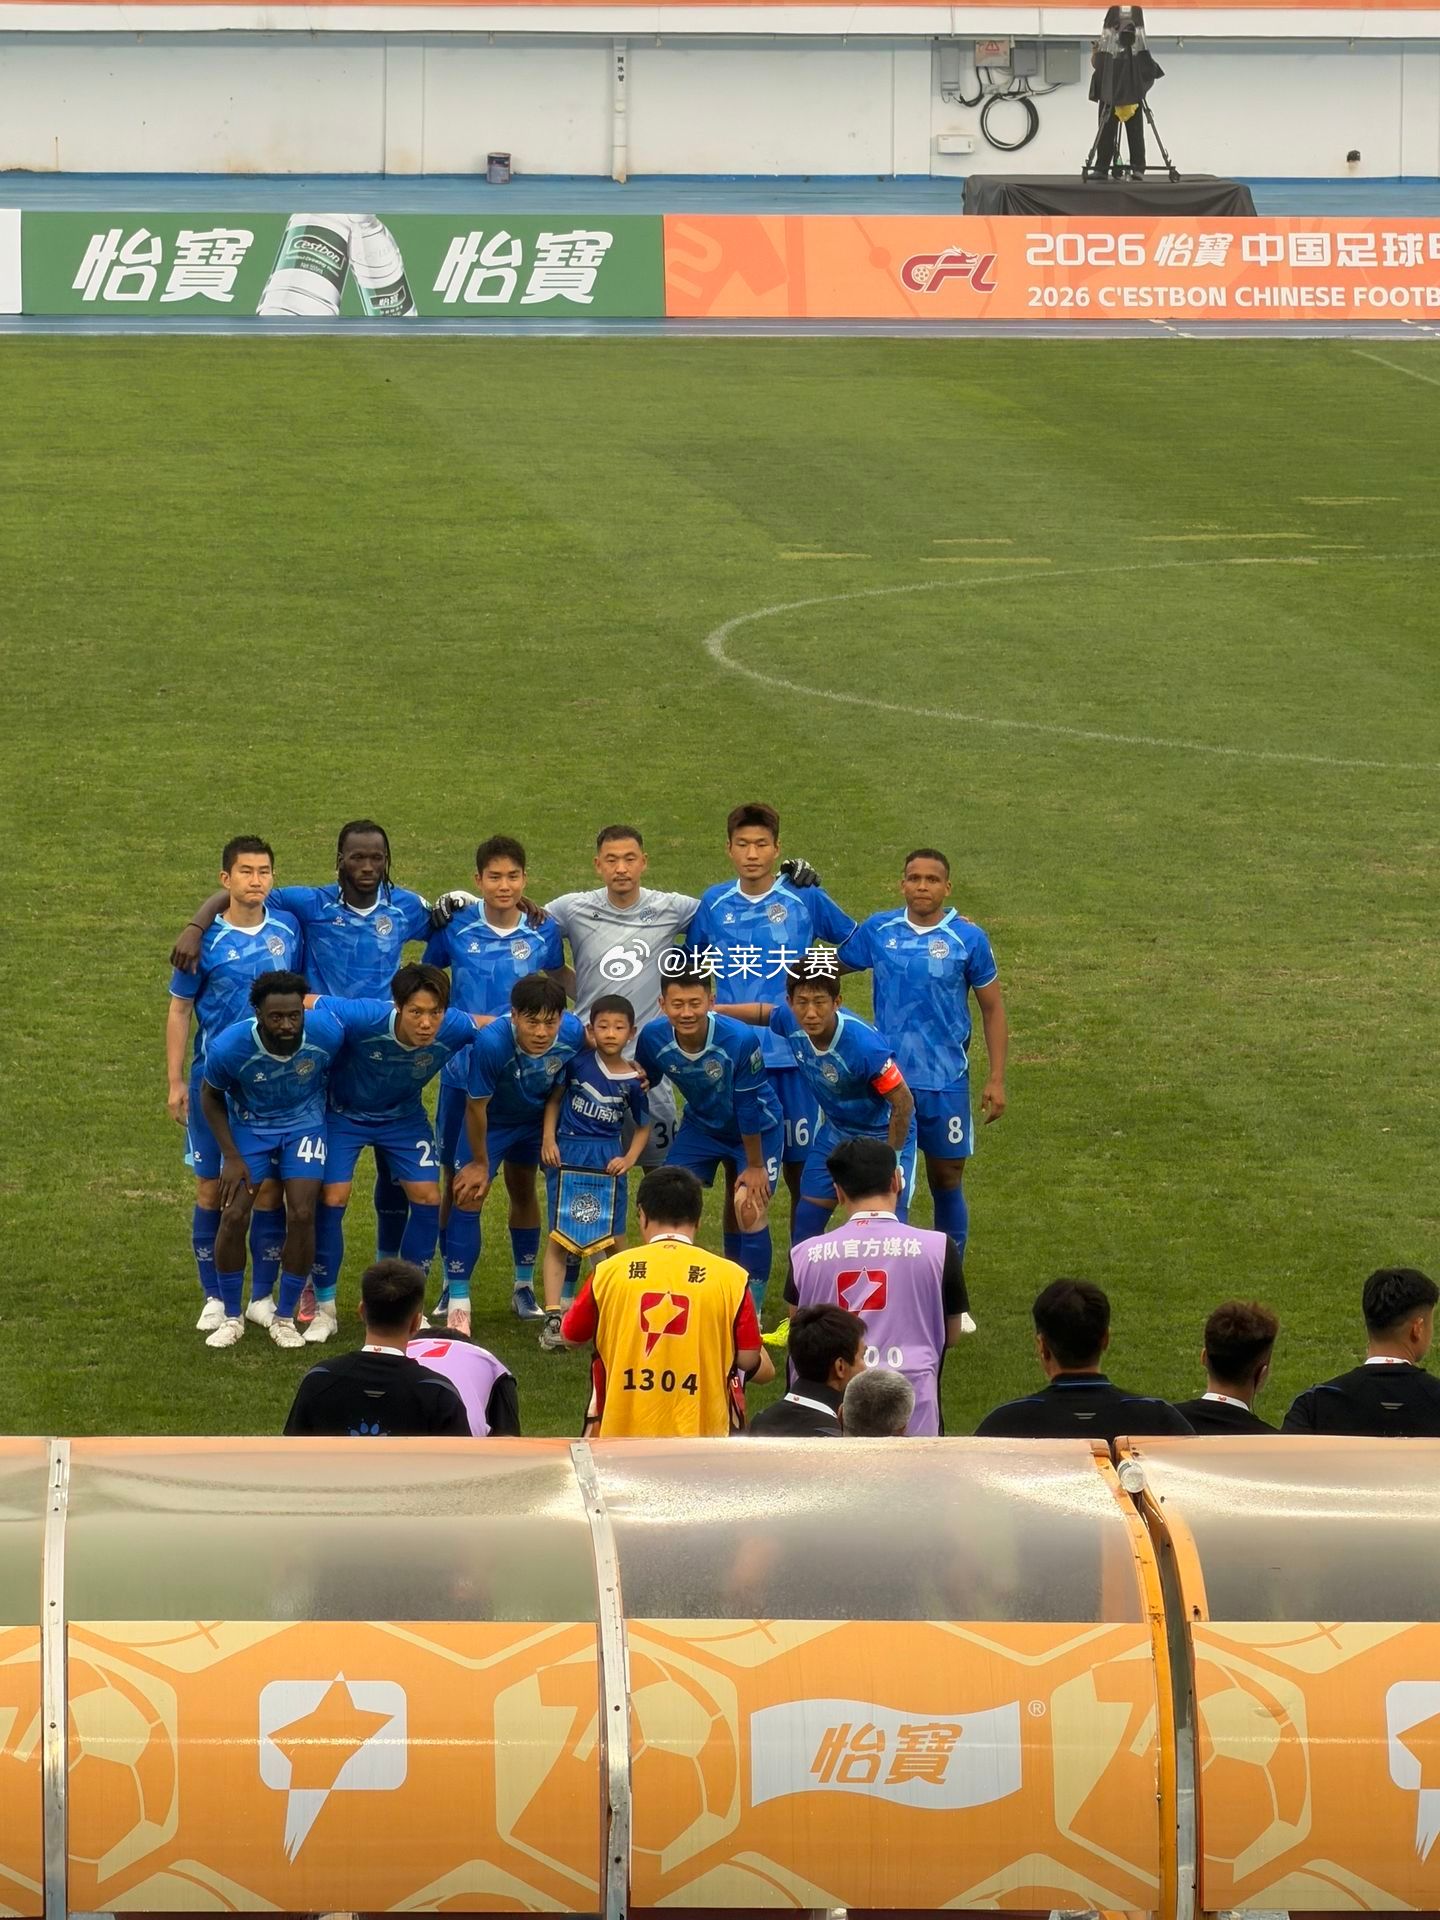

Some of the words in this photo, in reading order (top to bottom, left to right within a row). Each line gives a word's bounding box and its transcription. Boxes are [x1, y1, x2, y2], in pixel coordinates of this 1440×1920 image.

[1026, 233, 1146, 266] 2026
[1153, 232, 1234, 267] 怡寶
[1241, 232, 1440, 267] 中国足球
[71, 228, 255, 303] 怡寶
[432, 230, 614, 304] 怡寶
[901, 249, 998, 293] CFL
[1028, 286, 1091, 307] 2026
[1098, 286, 1227, 307] C'ESTBON
[1234, 286, 1346, 307] CHINESE
[1353, 286, 1440, 307] FOOTB
[784, 1118, 810, 1147] 16
[948, 1116, 964, 1144] 8
[297, 1135, 326, 1166] 44
[807, 1237, 922, 1263] 球队官方媒体
[623, 1368, 699, 1396] 1304
[809, 1722, 964, 1785] 怡寶
